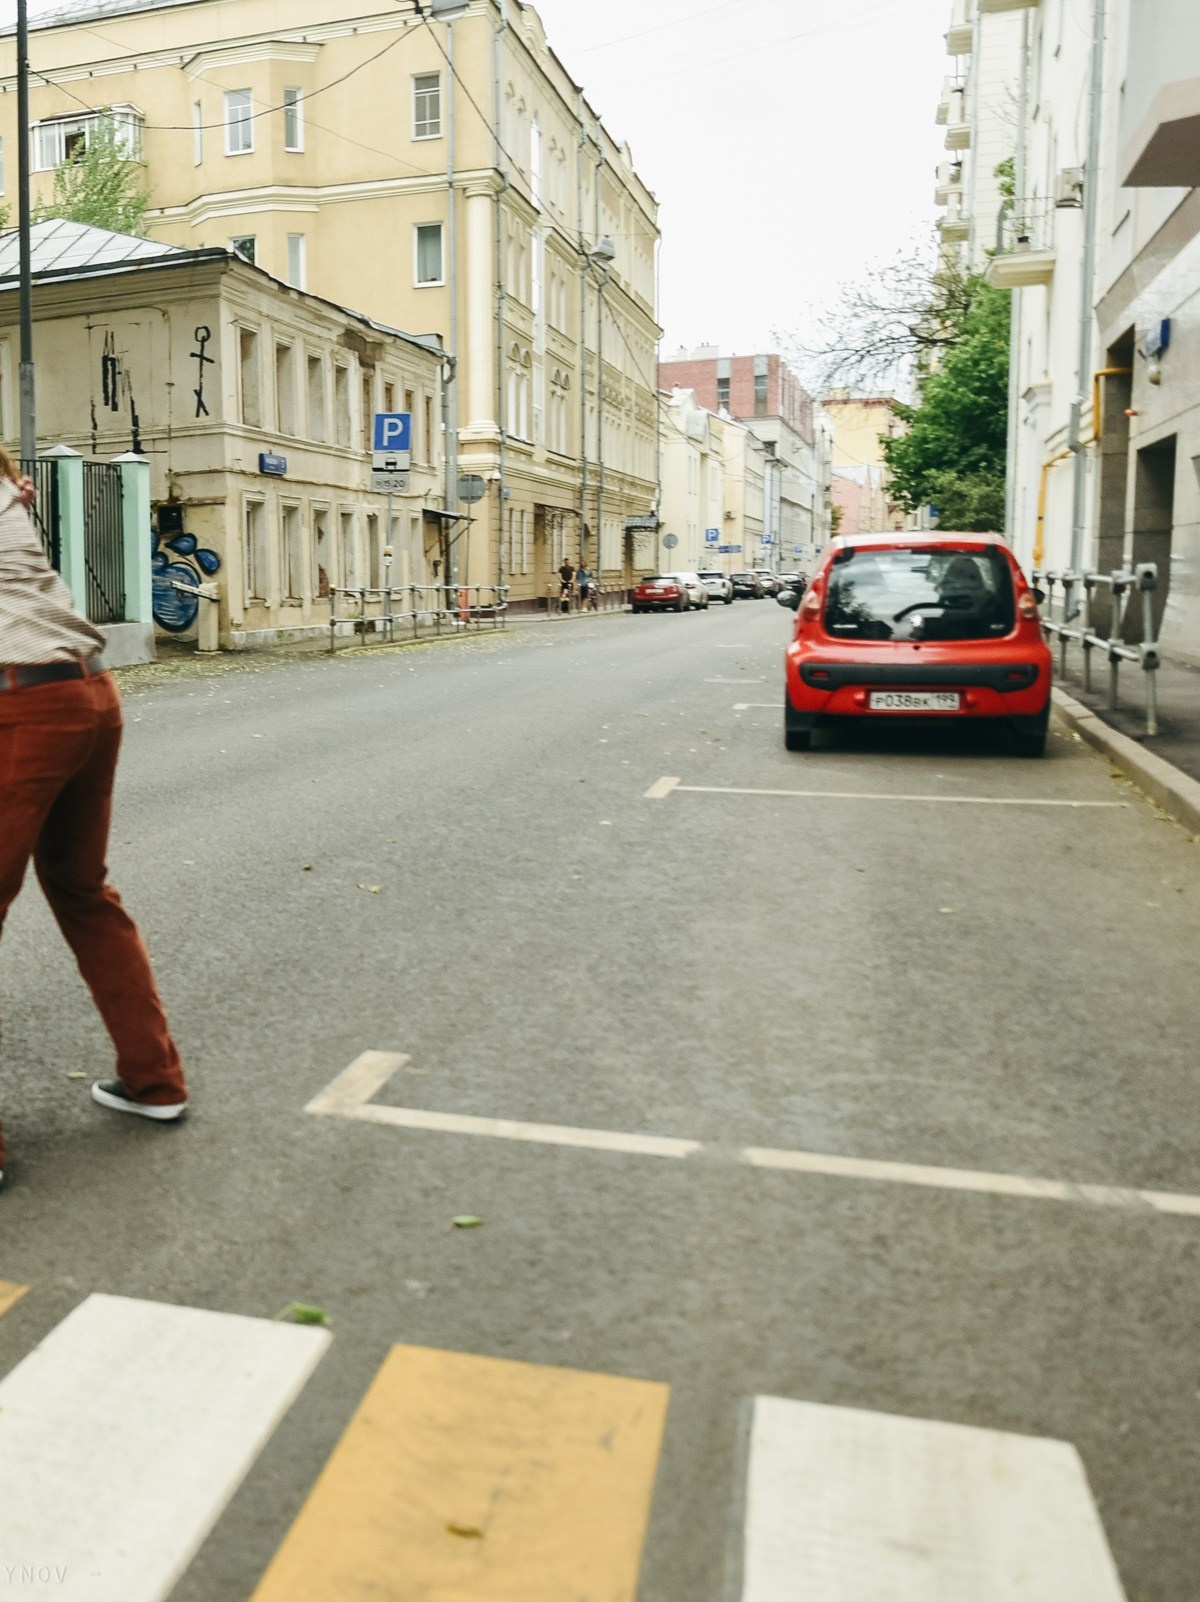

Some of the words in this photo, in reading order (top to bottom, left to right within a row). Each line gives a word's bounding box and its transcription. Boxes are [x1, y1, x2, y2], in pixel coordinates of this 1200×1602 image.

[382, 418, 403, 447] P
[393, 480, 405, 488] 20
[708, 530, 717, 540] P
